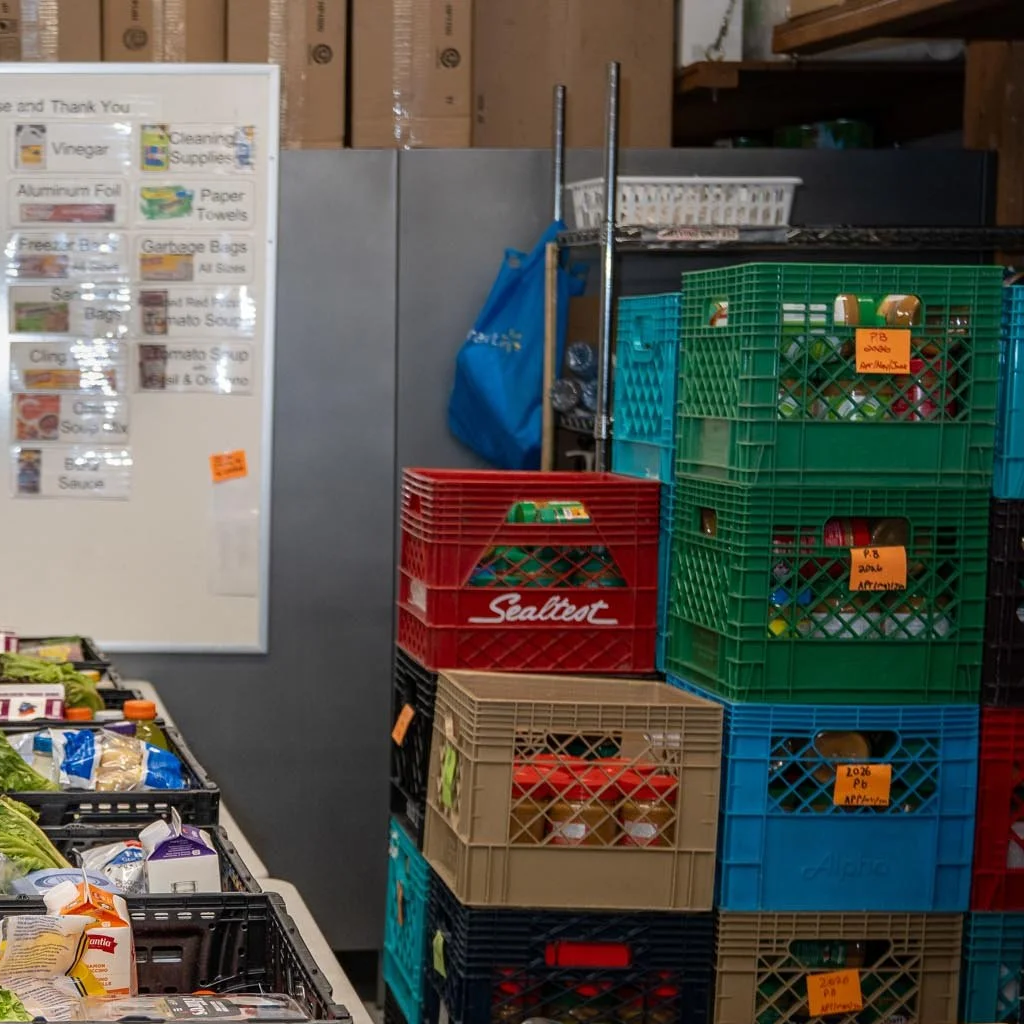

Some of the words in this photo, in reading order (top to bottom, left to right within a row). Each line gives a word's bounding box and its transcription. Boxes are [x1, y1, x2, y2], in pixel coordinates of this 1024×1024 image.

[17, 100, 44, 113] and
[51, 100, 96, 113] Thank
[101, 100, 130, 114] You
[170, 131, 239, 148] Cleaning
[51, 141, 109, 158] Vinegar
[170, 151, 233, 166] Supplies
[17, 184, 89, 197] Aluminum
[95, 184, 121, 197] Foil
[201, 189, 246, 204] Paper
[197, 208, 248, 221] Towels
[141, 239, 206, 255] Garbage
[210, 239, 248, 255] Bags
[199, 263, 213, 273] All
[216, 263, 246, 273] Sizes
[84, 307, 121, 323] Bags
[205, 313, 243, 329] Soup
[29, 349, 67, 367] Cling
[58, 476, 105, 490] Sauce
[468, 592, 619, 625] Sealtest
[88, 936, 112, 948] antia
